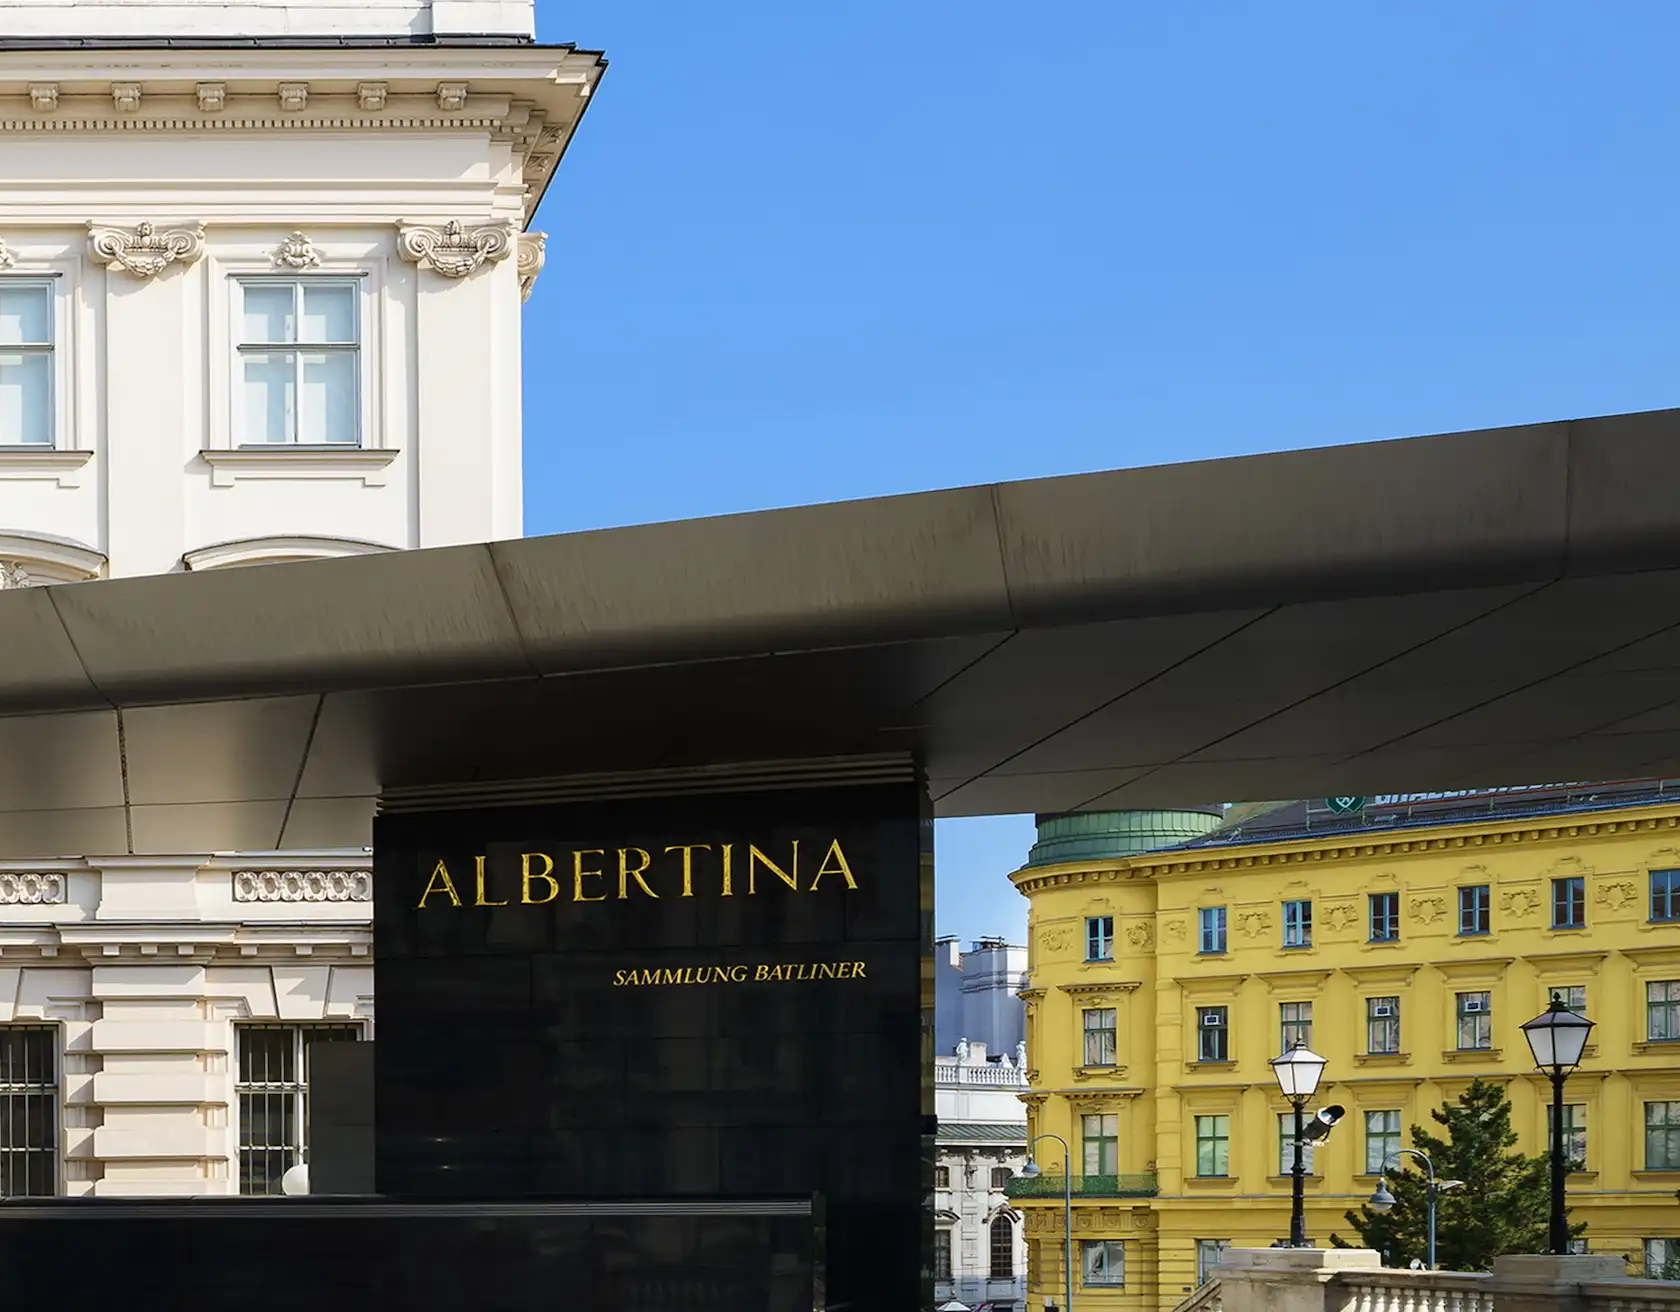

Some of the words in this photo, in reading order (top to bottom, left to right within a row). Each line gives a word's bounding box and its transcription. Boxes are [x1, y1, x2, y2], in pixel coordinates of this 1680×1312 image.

[416, 838, 859, 908] ALBERTINA
[613, 964, 748, 986] SAMMLUNG
[754, 960, 866, 982] BATLINER
